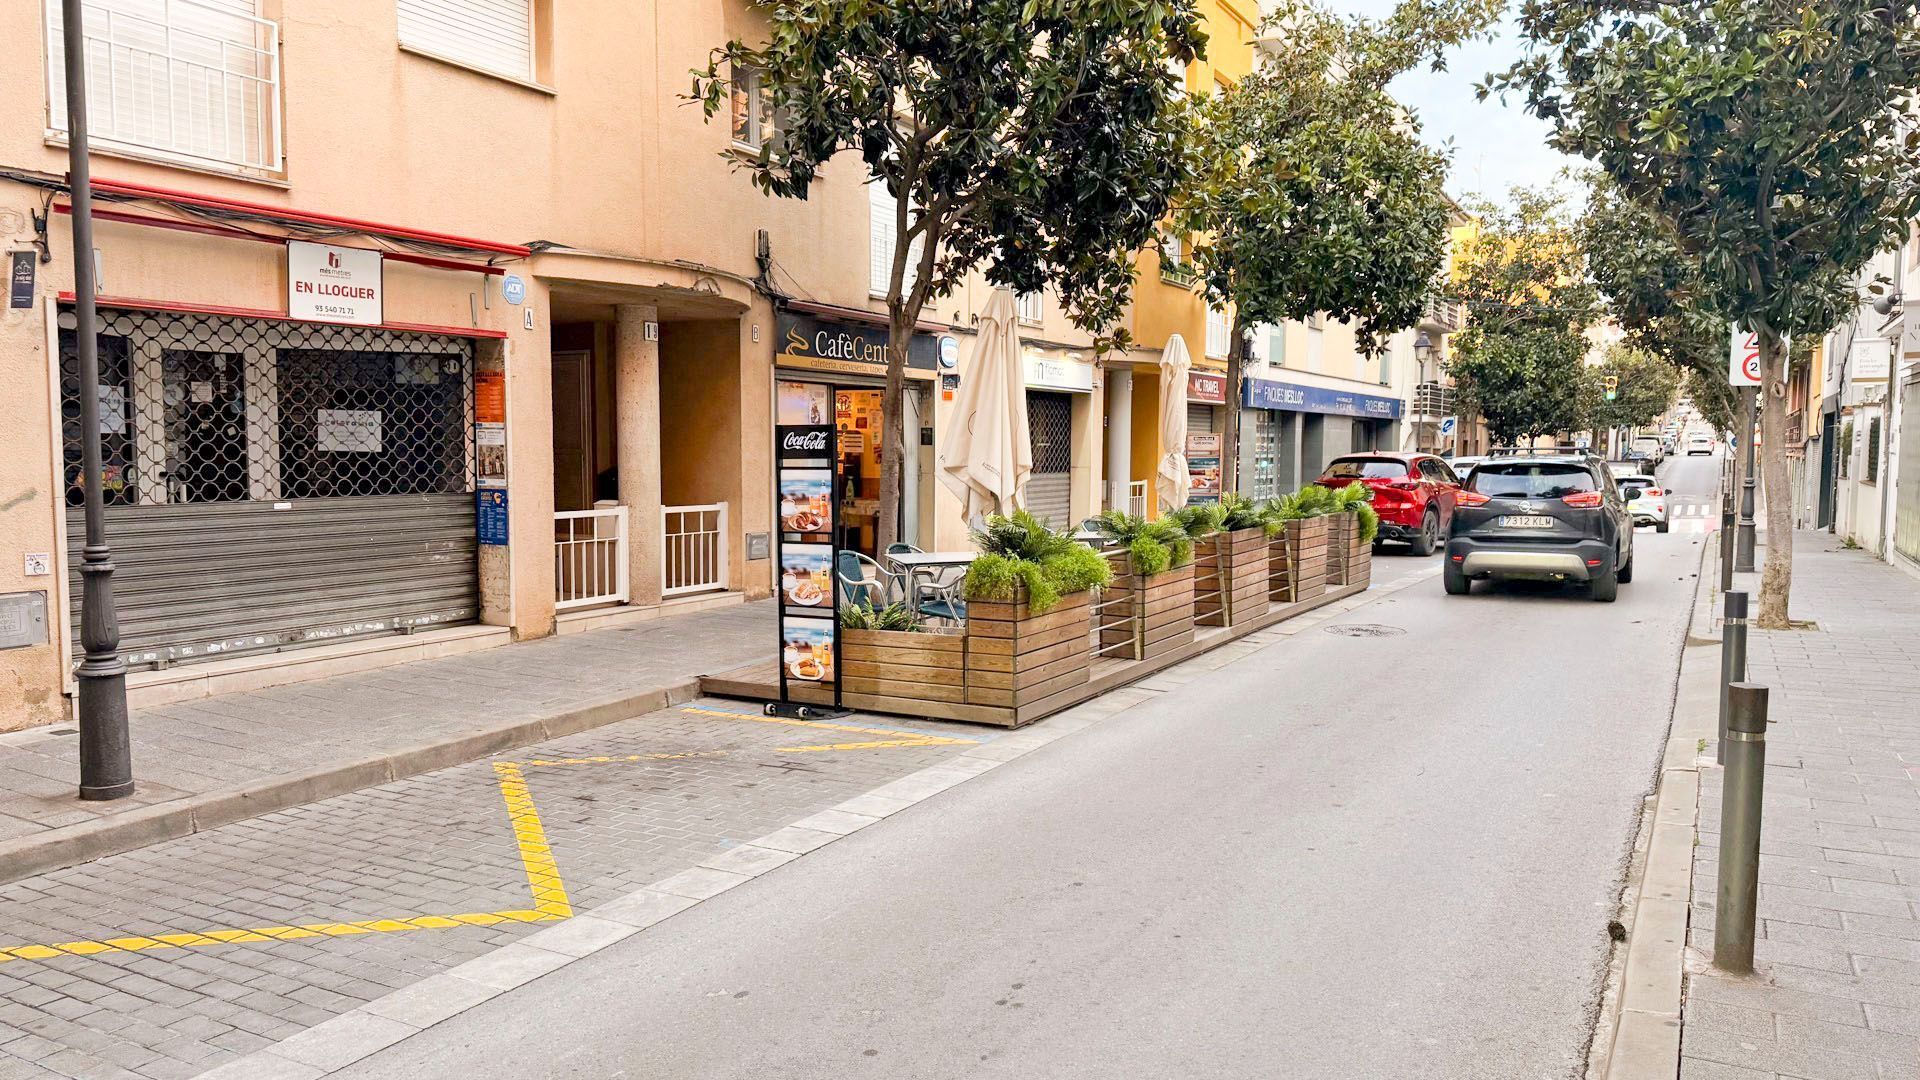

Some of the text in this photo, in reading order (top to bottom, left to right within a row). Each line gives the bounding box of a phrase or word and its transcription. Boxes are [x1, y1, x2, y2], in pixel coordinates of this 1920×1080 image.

[296, 280, 375, 300] EN LLOGUER
[526, 310, 532, 326] A
[754, 326, 758, 340] B
[815, 330, 909, 366] CafèCentl
[1202, 380, 1220, 394] TRAVEL
[1264, 386, 1304, 405] FINQUES MESLLOC
[784, 432, 828, 450] Coca-Cola
[1506, 516, 1530, 526] 7312
